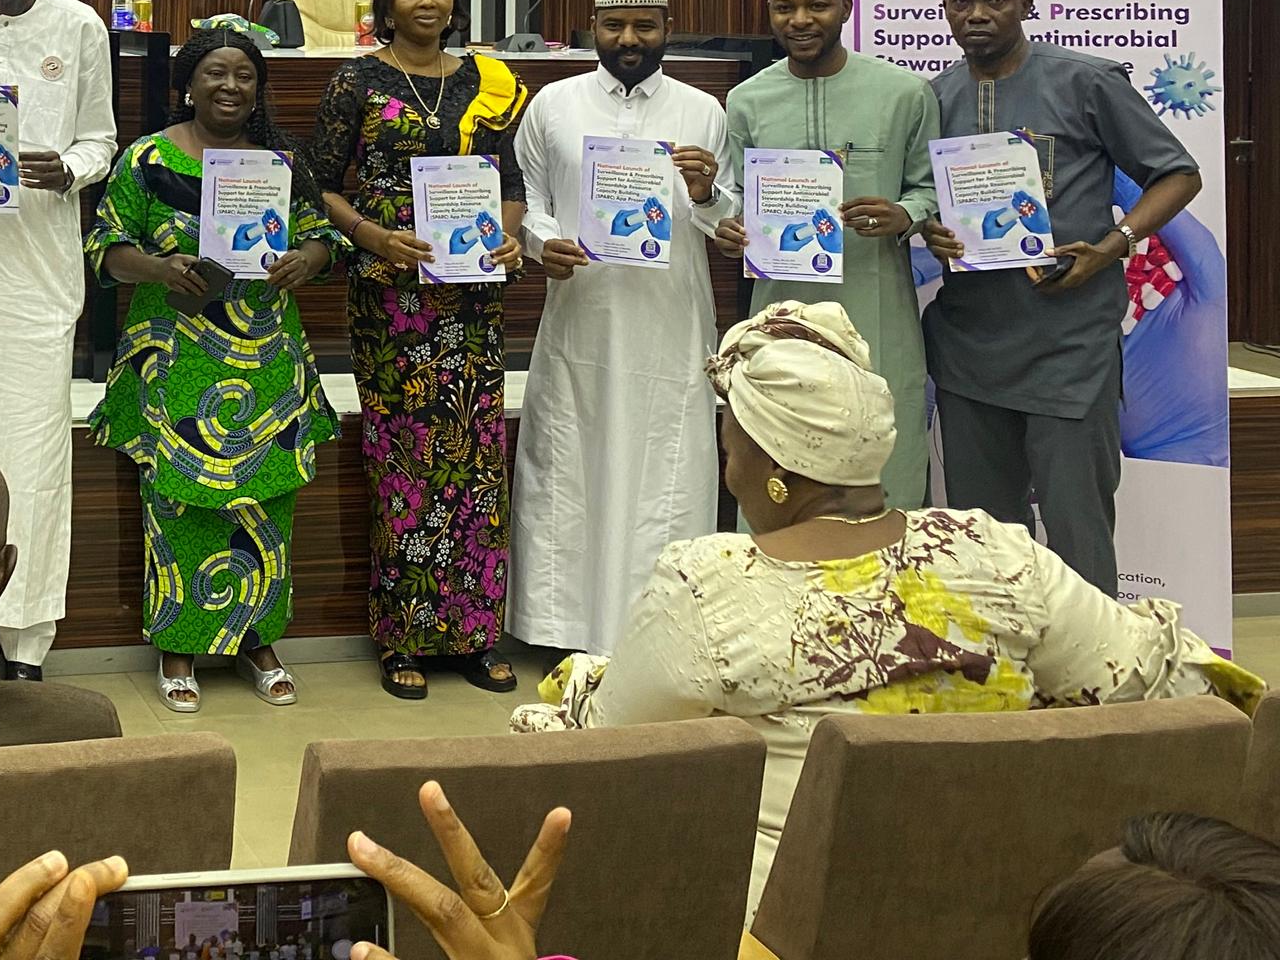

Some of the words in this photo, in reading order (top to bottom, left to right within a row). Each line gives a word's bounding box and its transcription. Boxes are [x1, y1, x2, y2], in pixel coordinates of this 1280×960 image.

[874, 4, 943, 20] Survei
[1027, 4, 1040, 20] &
[1051, 3, 1190, 25] Prescribing
[874, 29, 955, 50] Suppor
[1030, 29, 1178, 47] ntimicrobial
